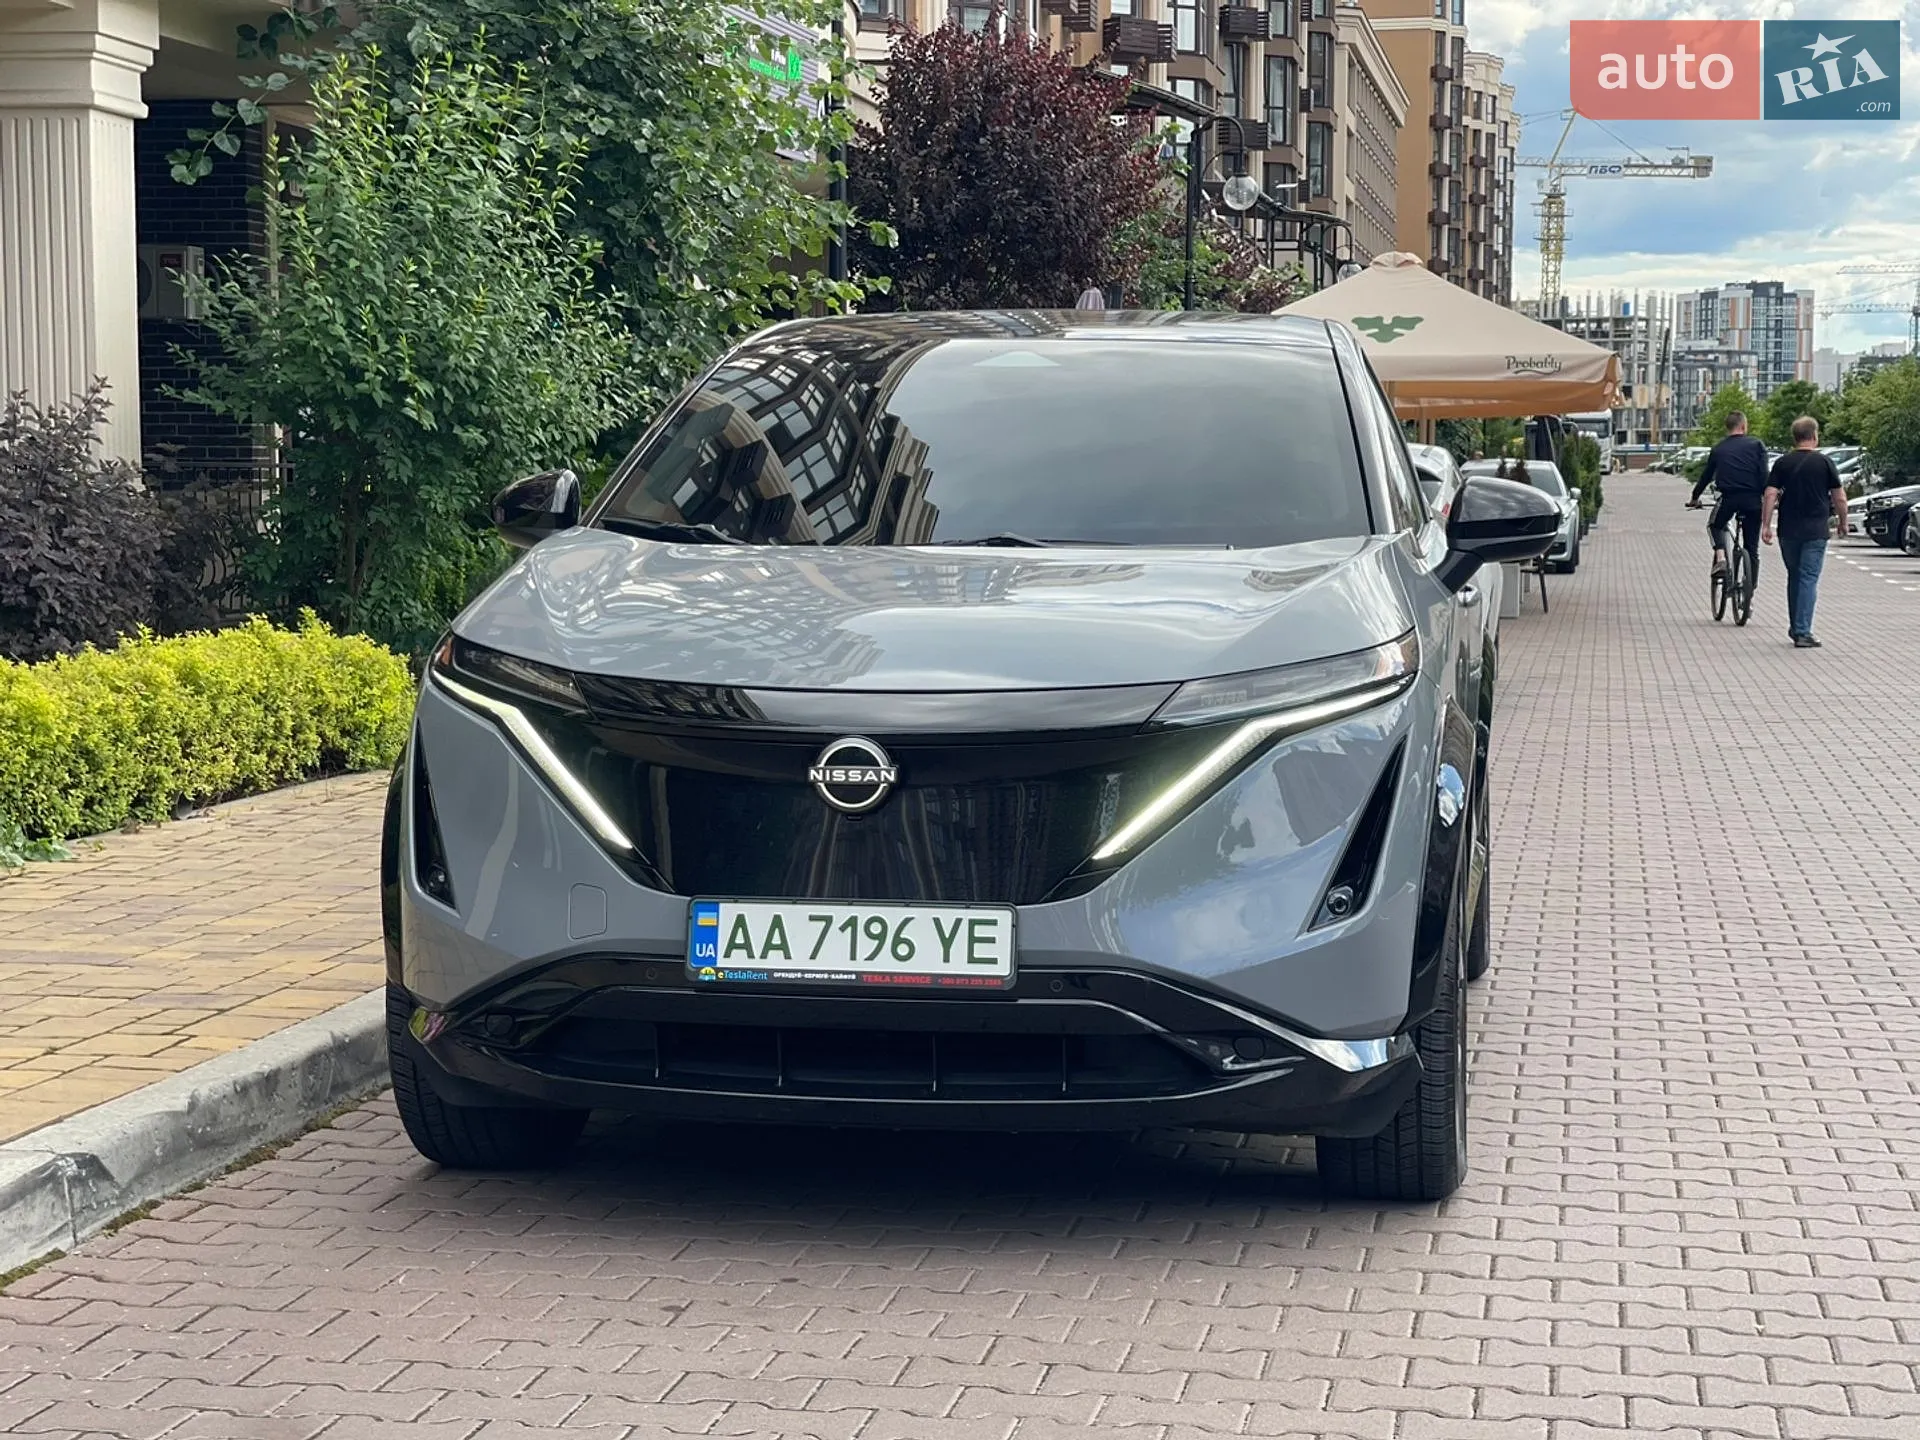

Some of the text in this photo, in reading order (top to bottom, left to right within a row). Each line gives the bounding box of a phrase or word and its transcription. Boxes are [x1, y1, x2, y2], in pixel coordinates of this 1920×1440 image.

[810, 769, 895, 782] NISSAN
[723, 914, 999, 965] AA 7196 YE
[696, 943, 716, 959] UA
[718, 970, 769, 980] eTeslaRent
[862, 974, 891, 984] TESLA
[893, 975, 933, 985] SERVICE
